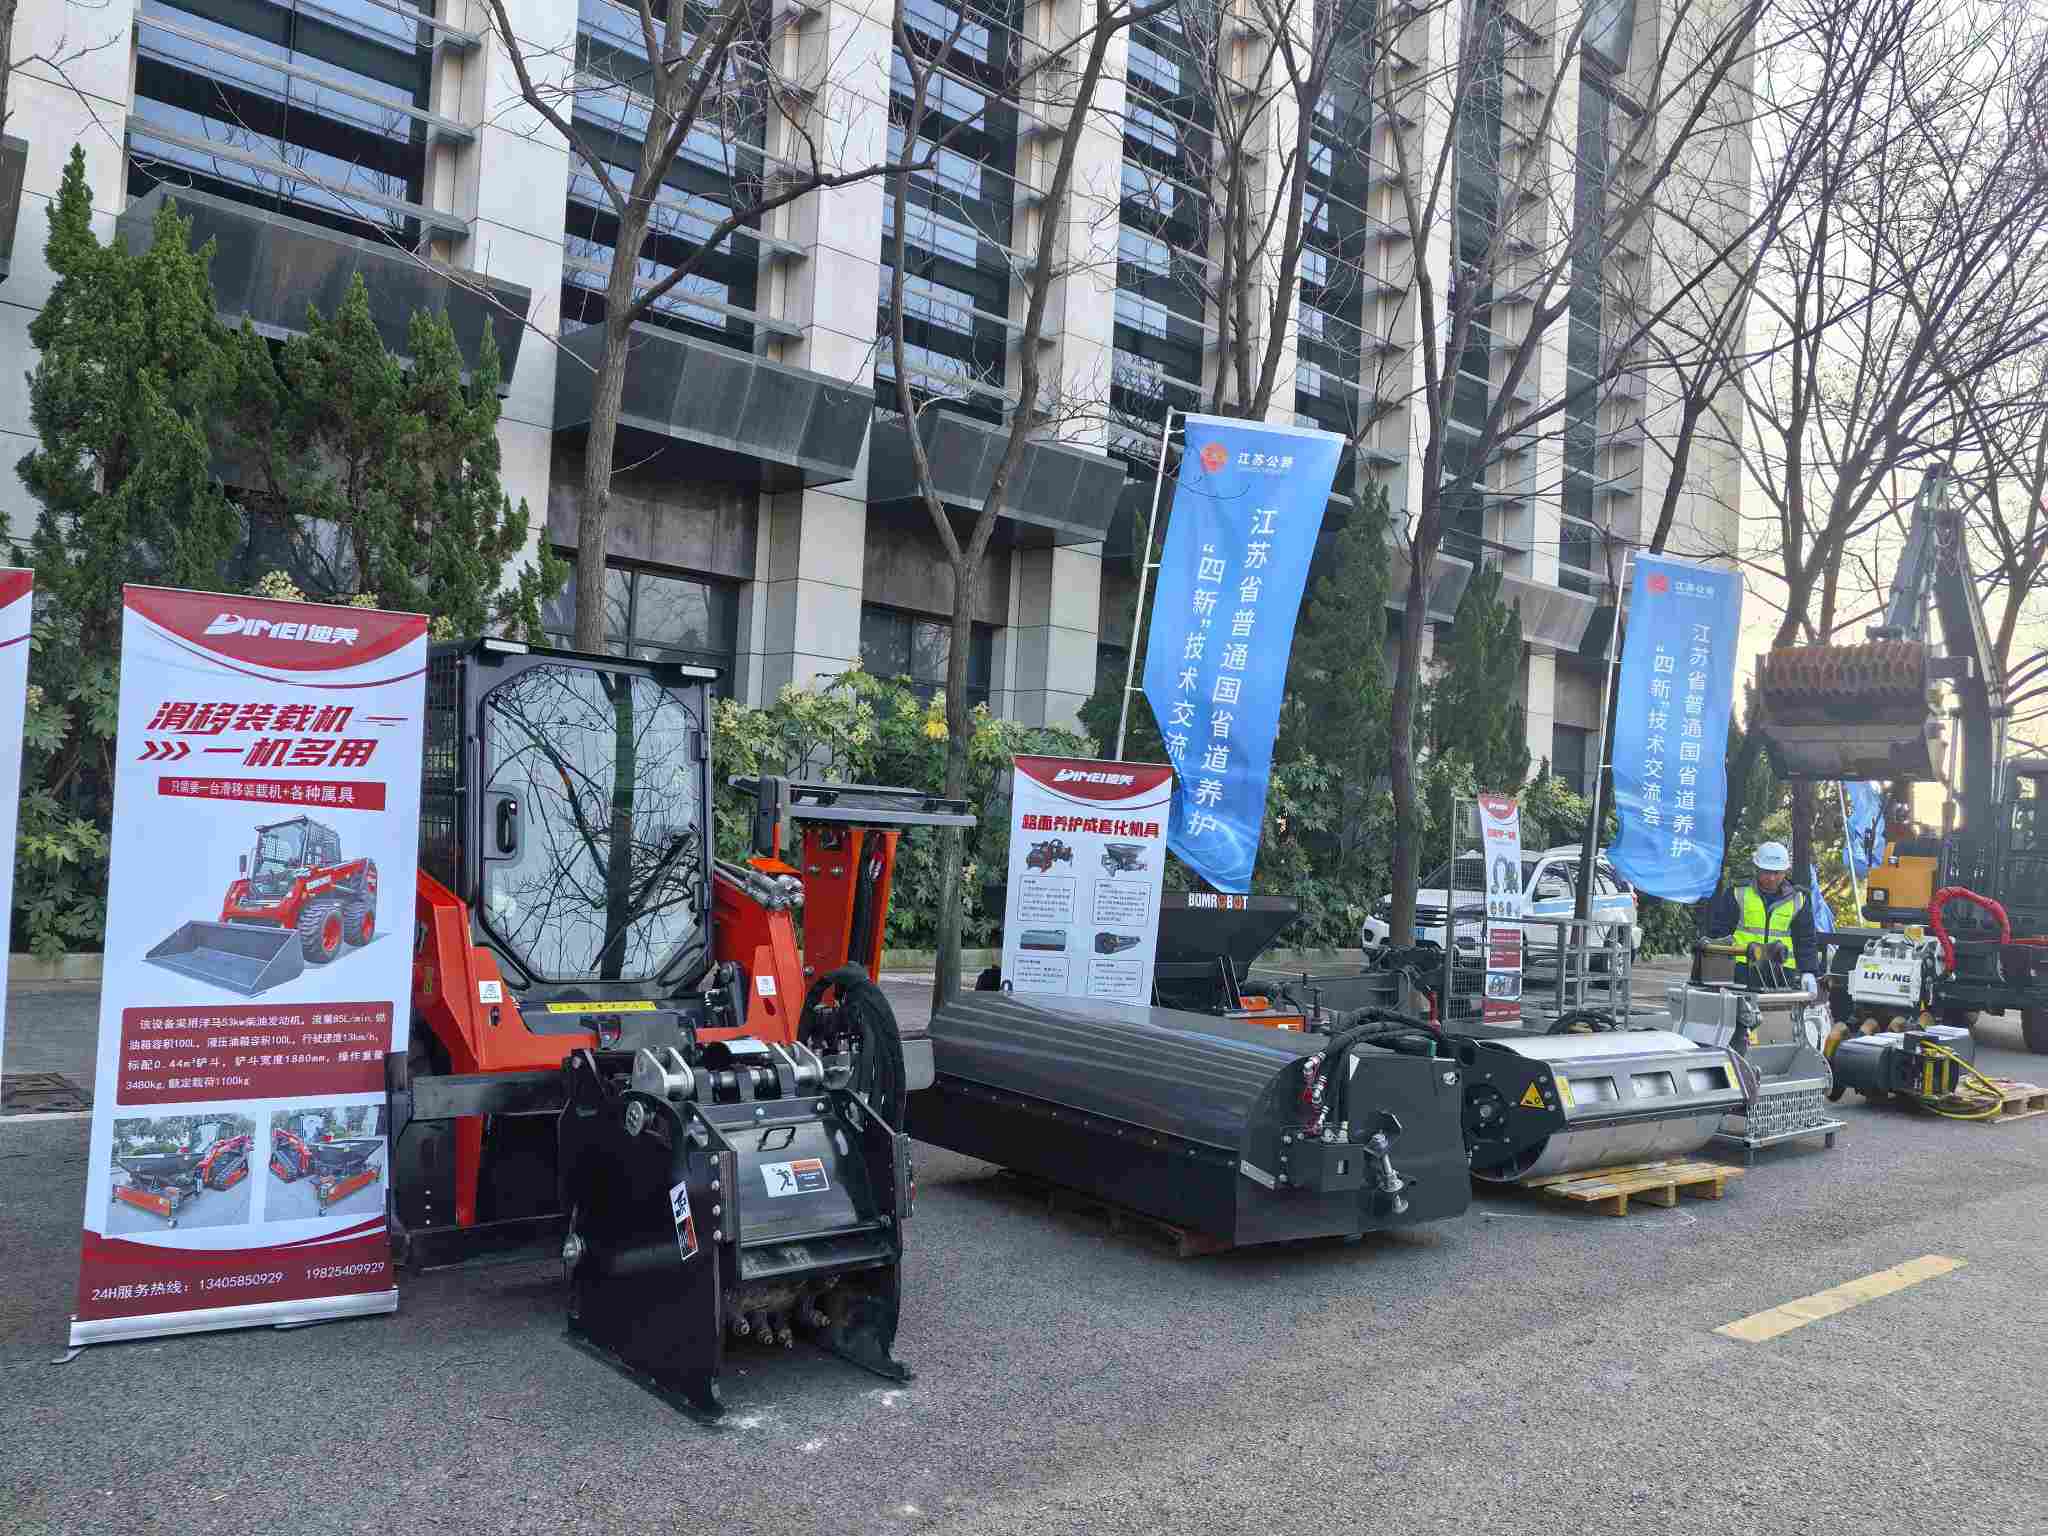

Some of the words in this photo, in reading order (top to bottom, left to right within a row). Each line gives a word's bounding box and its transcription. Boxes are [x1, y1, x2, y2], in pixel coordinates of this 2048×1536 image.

[1187, 508, 1279, 837] 江苏省普通国省道养护
[146, 701, 354, 735] 滑移装载机
[203, 738, 379, 768] 一机多用
[1671, 623, 1713, 857] 江苏省普通国省道养护
[1863, 971, 1912, 983] LIYANG
[199, 1271, 284, 1290] 13405850929
[305, 1261, 385, 1280] 19825409929
